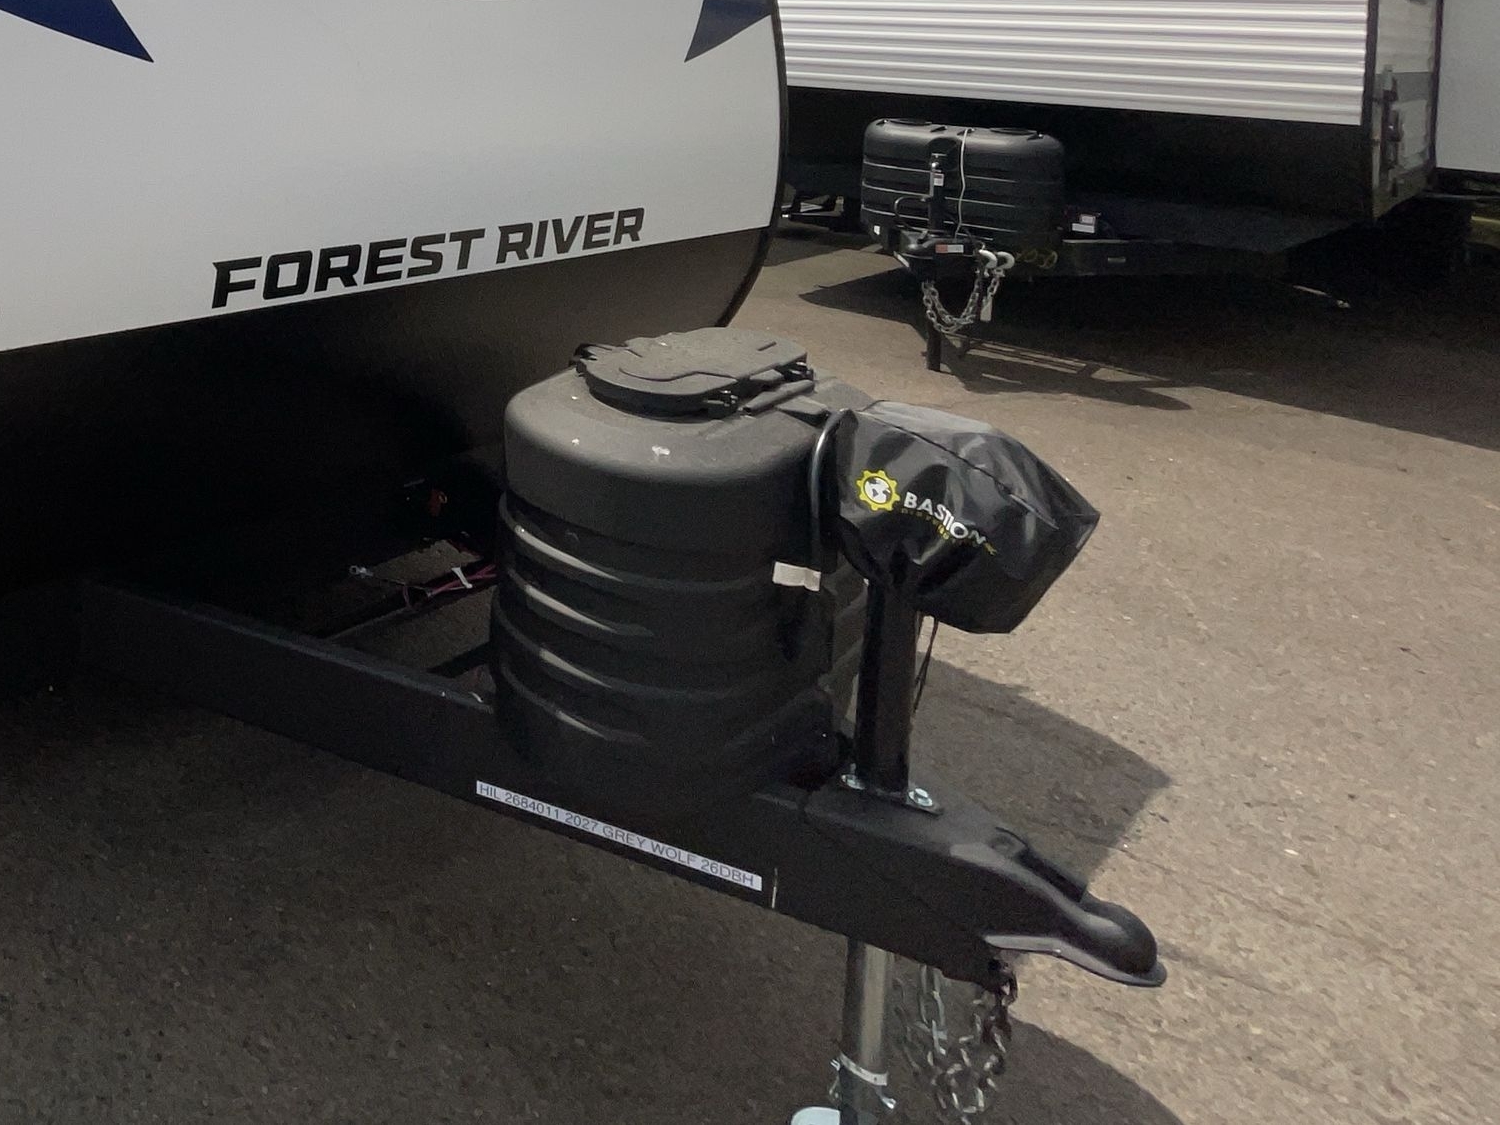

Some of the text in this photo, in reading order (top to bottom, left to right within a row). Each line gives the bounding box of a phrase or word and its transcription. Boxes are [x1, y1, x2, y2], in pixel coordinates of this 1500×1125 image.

[210, 207, 645, 309] FOREST RIVER
[479, 783, 754, 888] HIL 2684011 2027 GREY WOLF 26DBH
